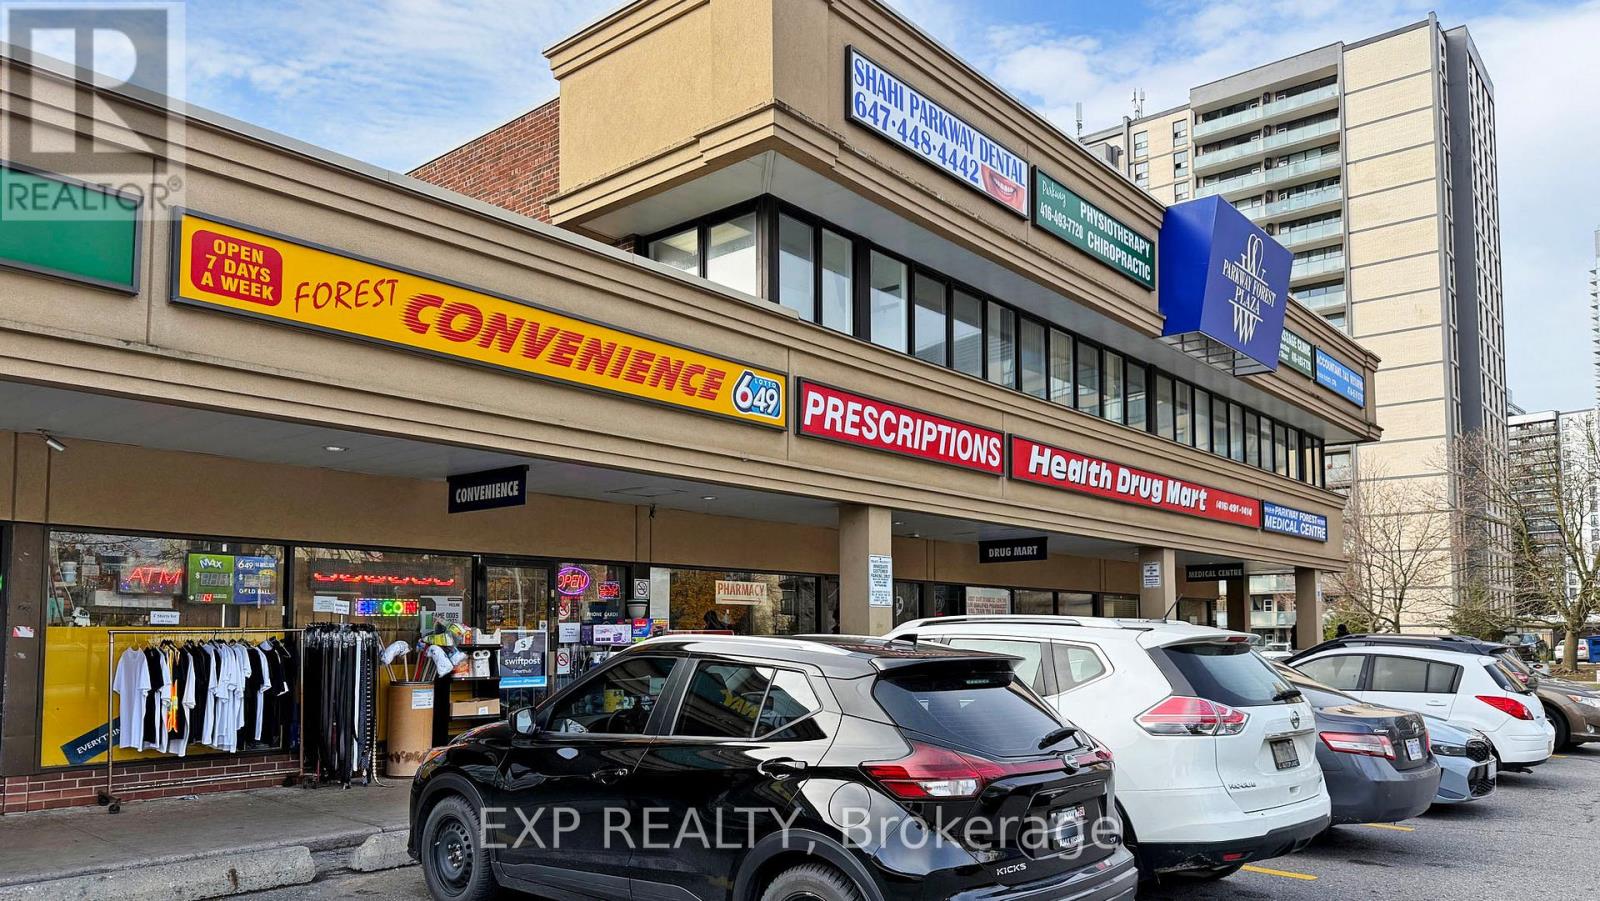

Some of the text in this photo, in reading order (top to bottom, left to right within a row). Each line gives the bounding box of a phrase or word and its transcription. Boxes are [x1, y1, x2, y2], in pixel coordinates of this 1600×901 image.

[854, 58, 1026, 187] SHAHI PARKWAY DENTAL
[1080, 201, 1150, 258] PHYSIOTHERAPY
[213, 239, 264, 265] OPEN
[1087, 231, 1151, 281] CHIROPRACTIC
[206, 254, 271, 282] 7 DAYS
[201, 272, 274, 301] A WEEK
[1222, 259, 1277, 308] PARKWAY FOREST
[1235, 285, 1260, 316] PLAZA
[294, 279, 727, 401] FOREST CONVENIENCE
[754, 377, 777, 388] LOTTO
[804, 390, 1001, 467] PRESCRIPTIONS
[1028, 445, 1208, 511] Health Drug Mart
[455, 480, 519, 503] CONVENIENCE
[1265, 515, 1298, 533] MEDICAL
[1300, 523, 1326, 538] CENTRE
[1274, 506, 1299, 519] PARKWAY
[1299, 512, 1317, 524] FOREST
[988, 545, 1038, 558] DRUG MART
[127, 567, 183, 584] ATM
[558, 575, 586, 588] OPEN
[1188, 569, 1242, 578] MEDICAL CENTRE
[717, 581, 765, 596] PHARMACY
[504, 656, 541, 667] swiftpost
[996, 862, 1027, 876] KICKS
